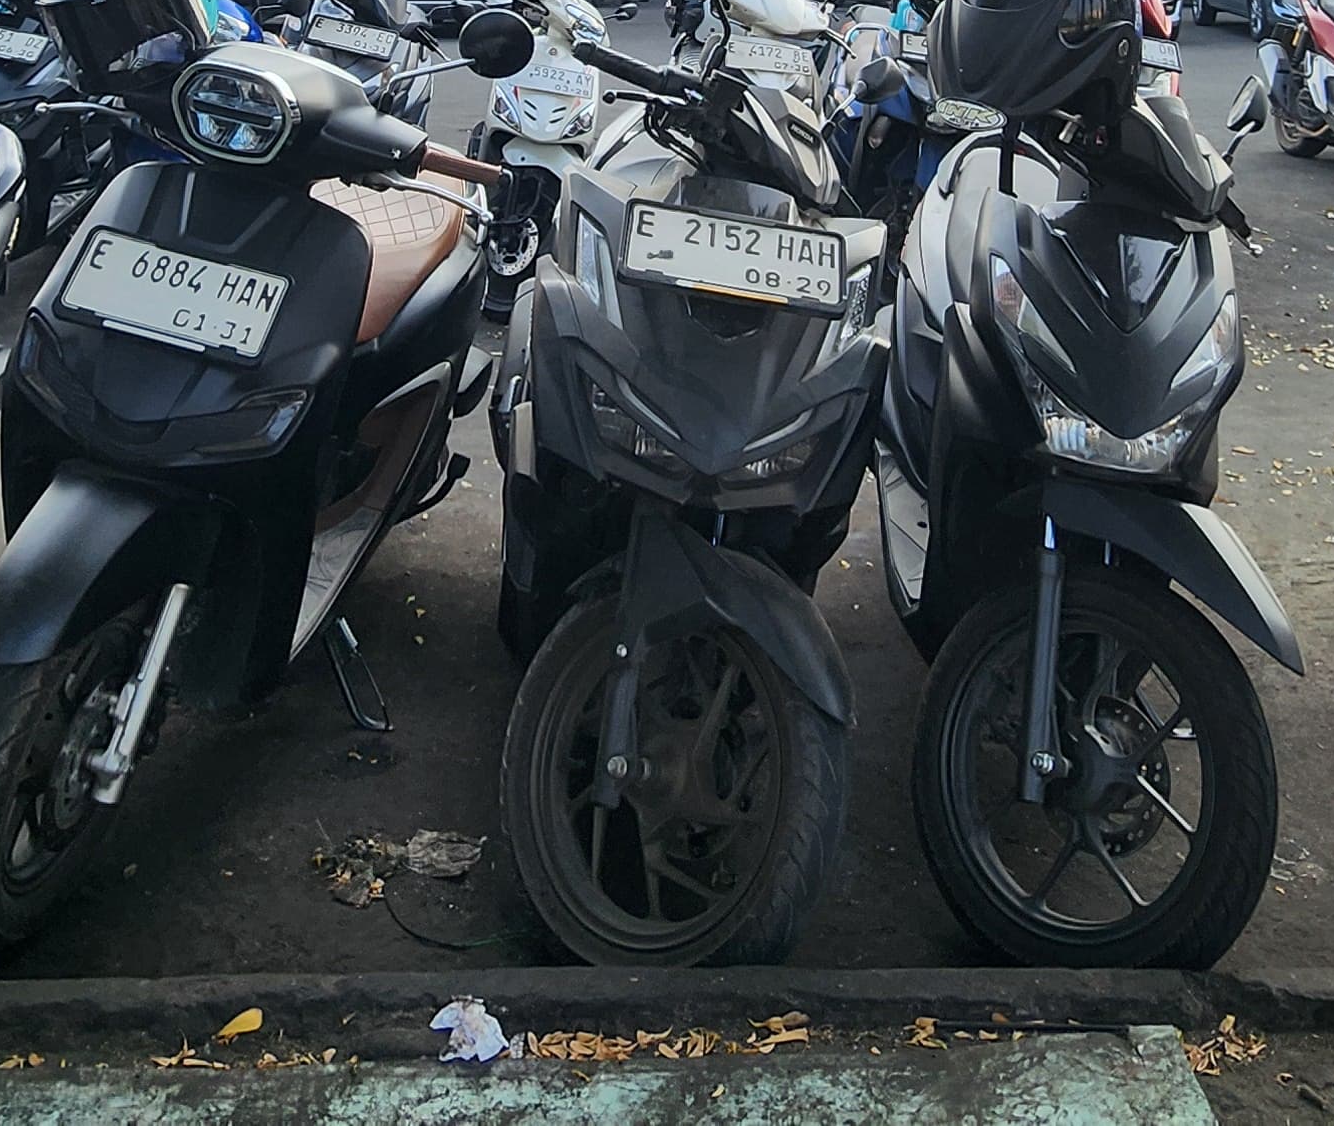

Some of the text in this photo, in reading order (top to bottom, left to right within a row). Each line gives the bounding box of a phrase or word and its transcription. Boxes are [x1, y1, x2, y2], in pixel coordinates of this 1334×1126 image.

[316, 18, 325, 29] E
[336, 22, 367, 38] 3394
[728, 42, 735, 53] E
[750, 45, 783, 59] 4172
[906, 36, 913, 46] E
[938, 101, 998, 124] INK
[636, 210, 836, 269] E 2152 HAH
[90, 239, 279, 313] E 6884 HAN
